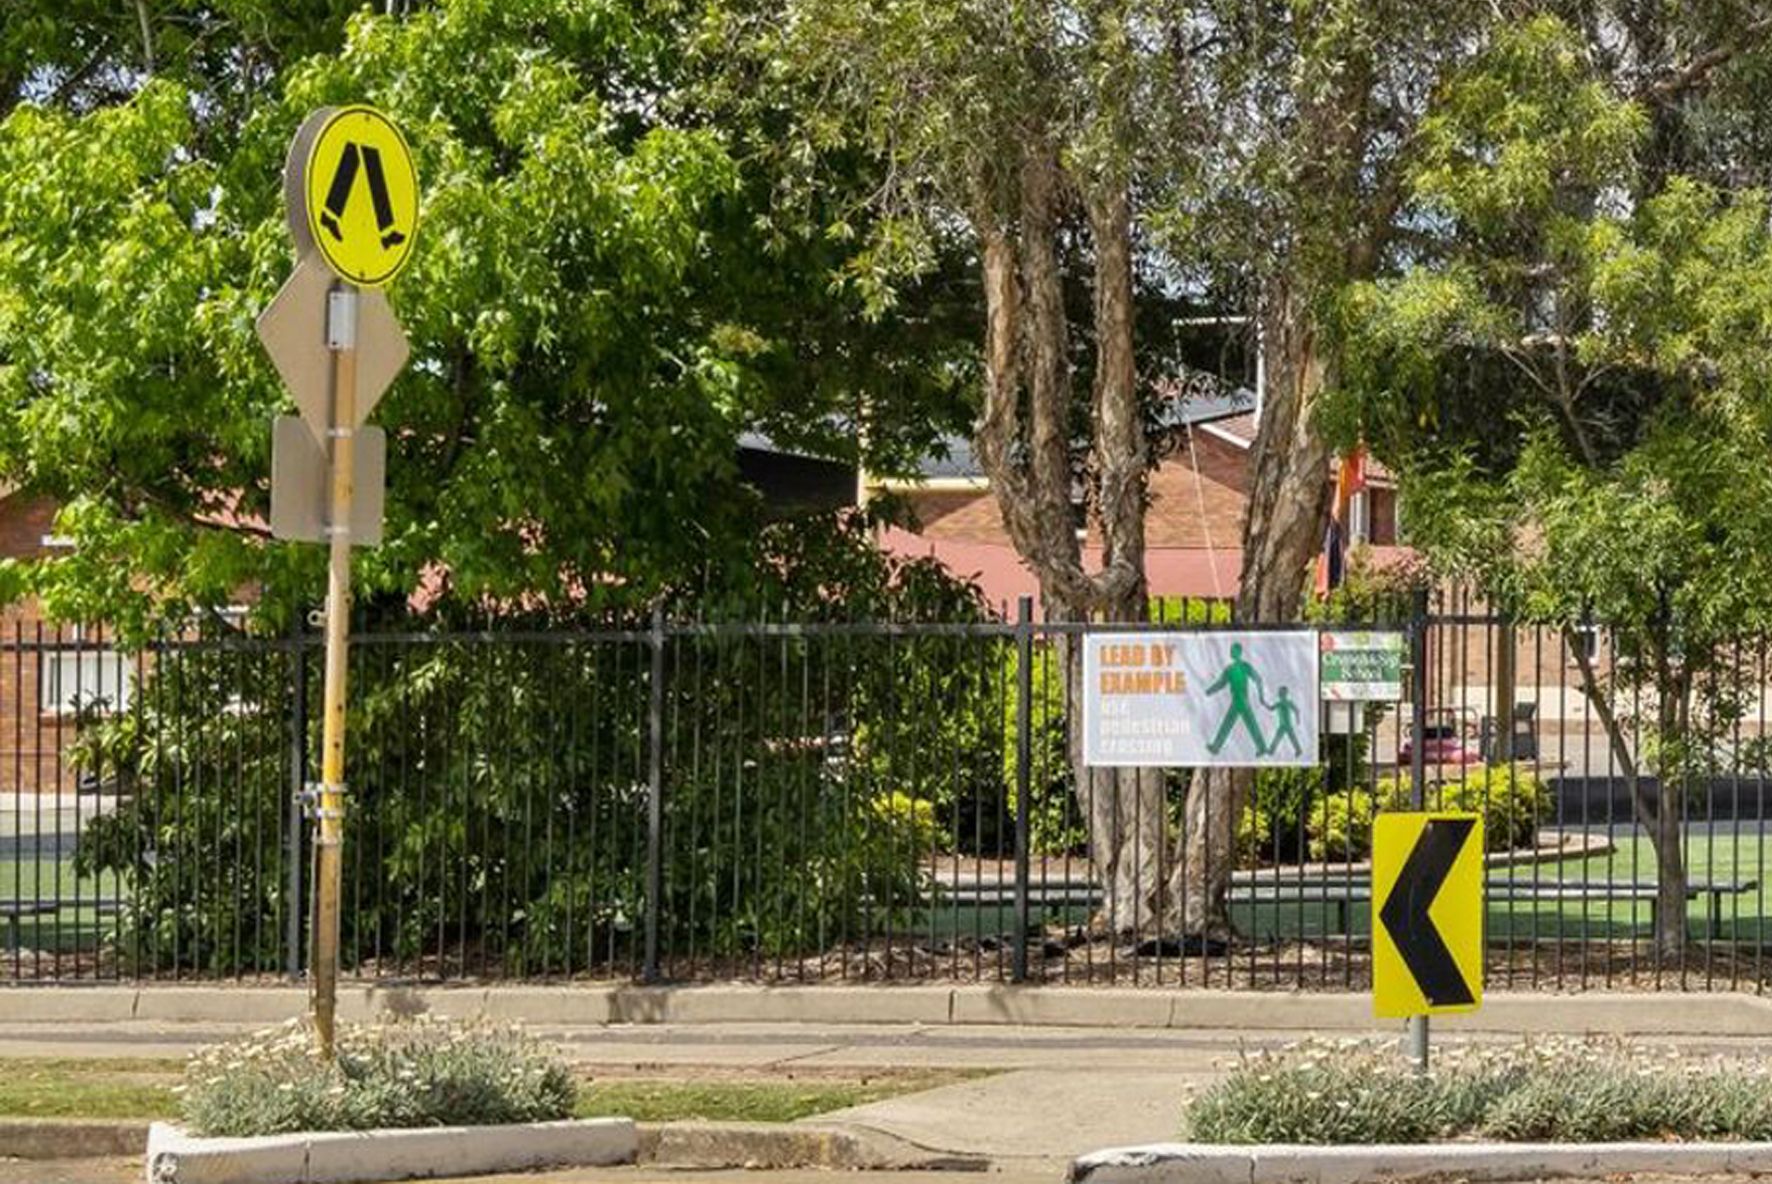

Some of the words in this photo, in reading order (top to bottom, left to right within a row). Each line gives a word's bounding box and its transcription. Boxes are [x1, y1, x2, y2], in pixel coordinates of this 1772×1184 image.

[1100, 643, 1145, 667] LEAD
[1150, 643, 1177, 667] BY
[1100, 670, 1187, 694] EXAMPLE
